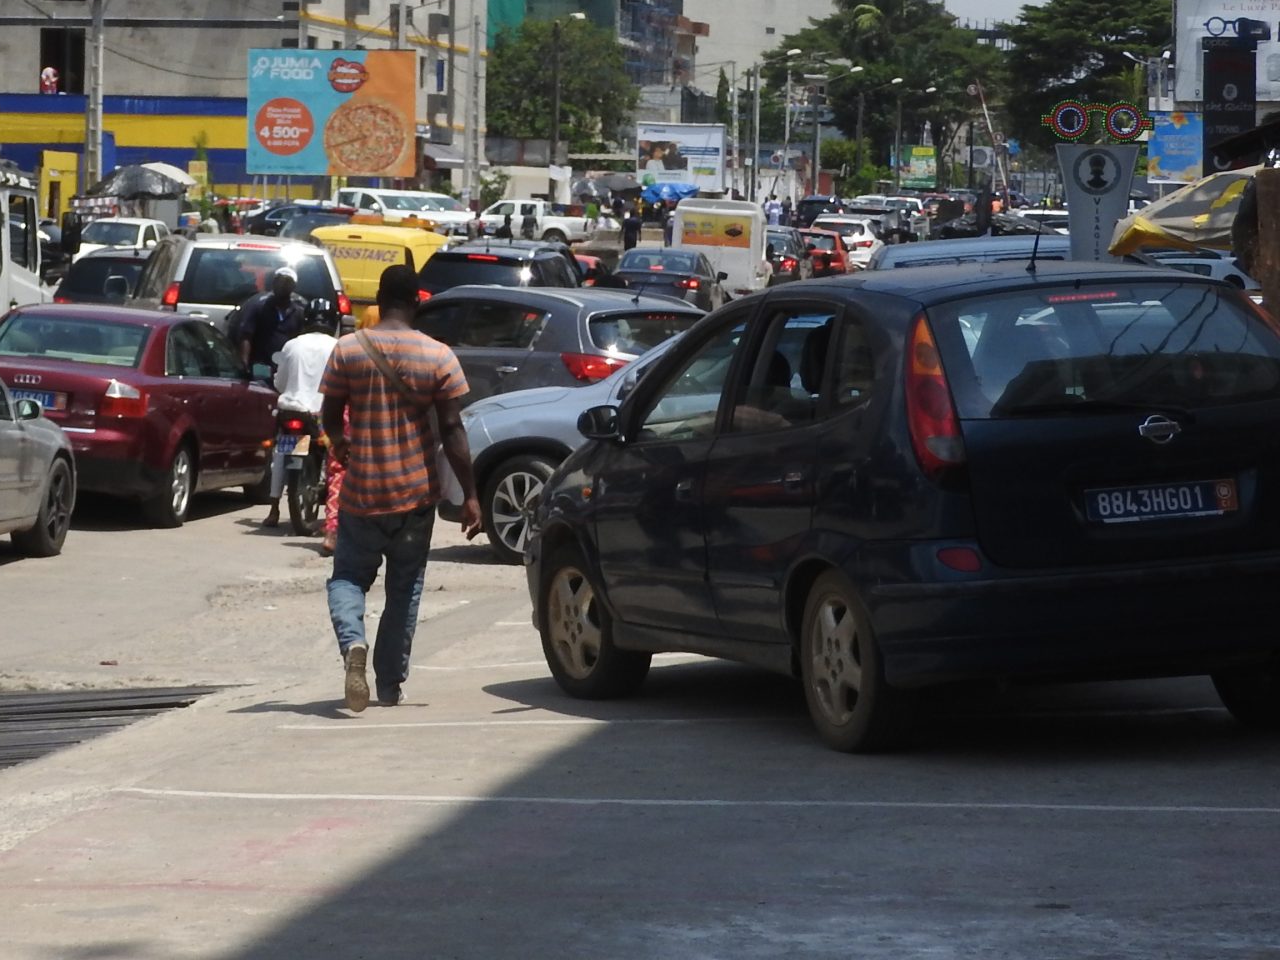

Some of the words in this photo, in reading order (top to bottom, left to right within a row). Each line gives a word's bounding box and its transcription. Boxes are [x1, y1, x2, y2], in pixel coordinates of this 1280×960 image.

[272, 57, 321, 69] JUMIA
[270, 68, 315, 80] FOOD
[260, 126, 270, 138] 4
[272, 126, 300, 138] 500
[1097, 486, 1204, 515] 8843HG01
